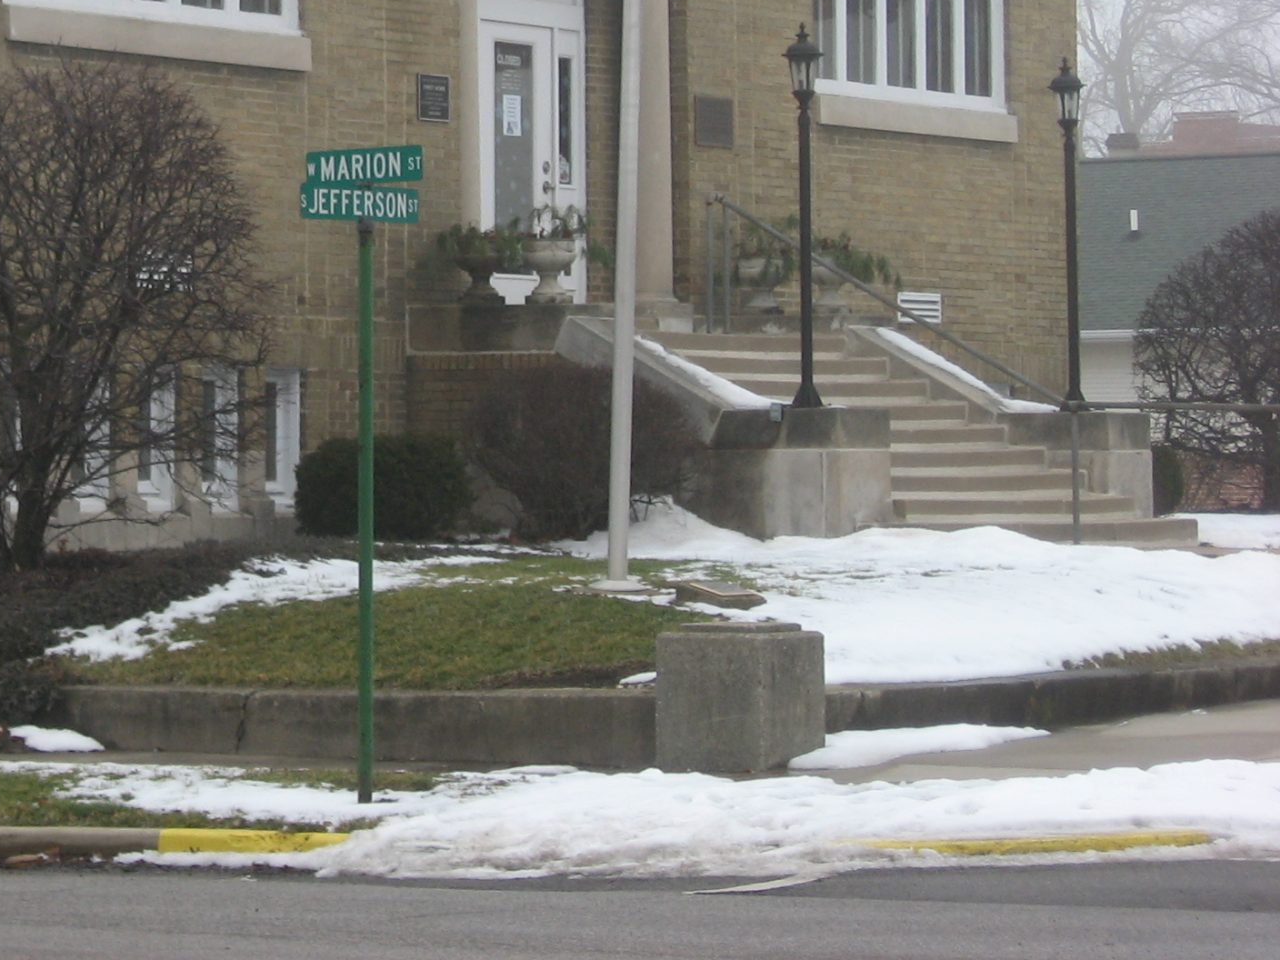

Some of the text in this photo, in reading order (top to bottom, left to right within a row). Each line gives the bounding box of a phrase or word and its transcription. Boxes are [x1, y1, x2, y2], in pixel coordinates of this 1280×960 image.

[307, 151, 422, 182] W MARION ST
[300, 188, 419, 218] S JEFFERSON ST
